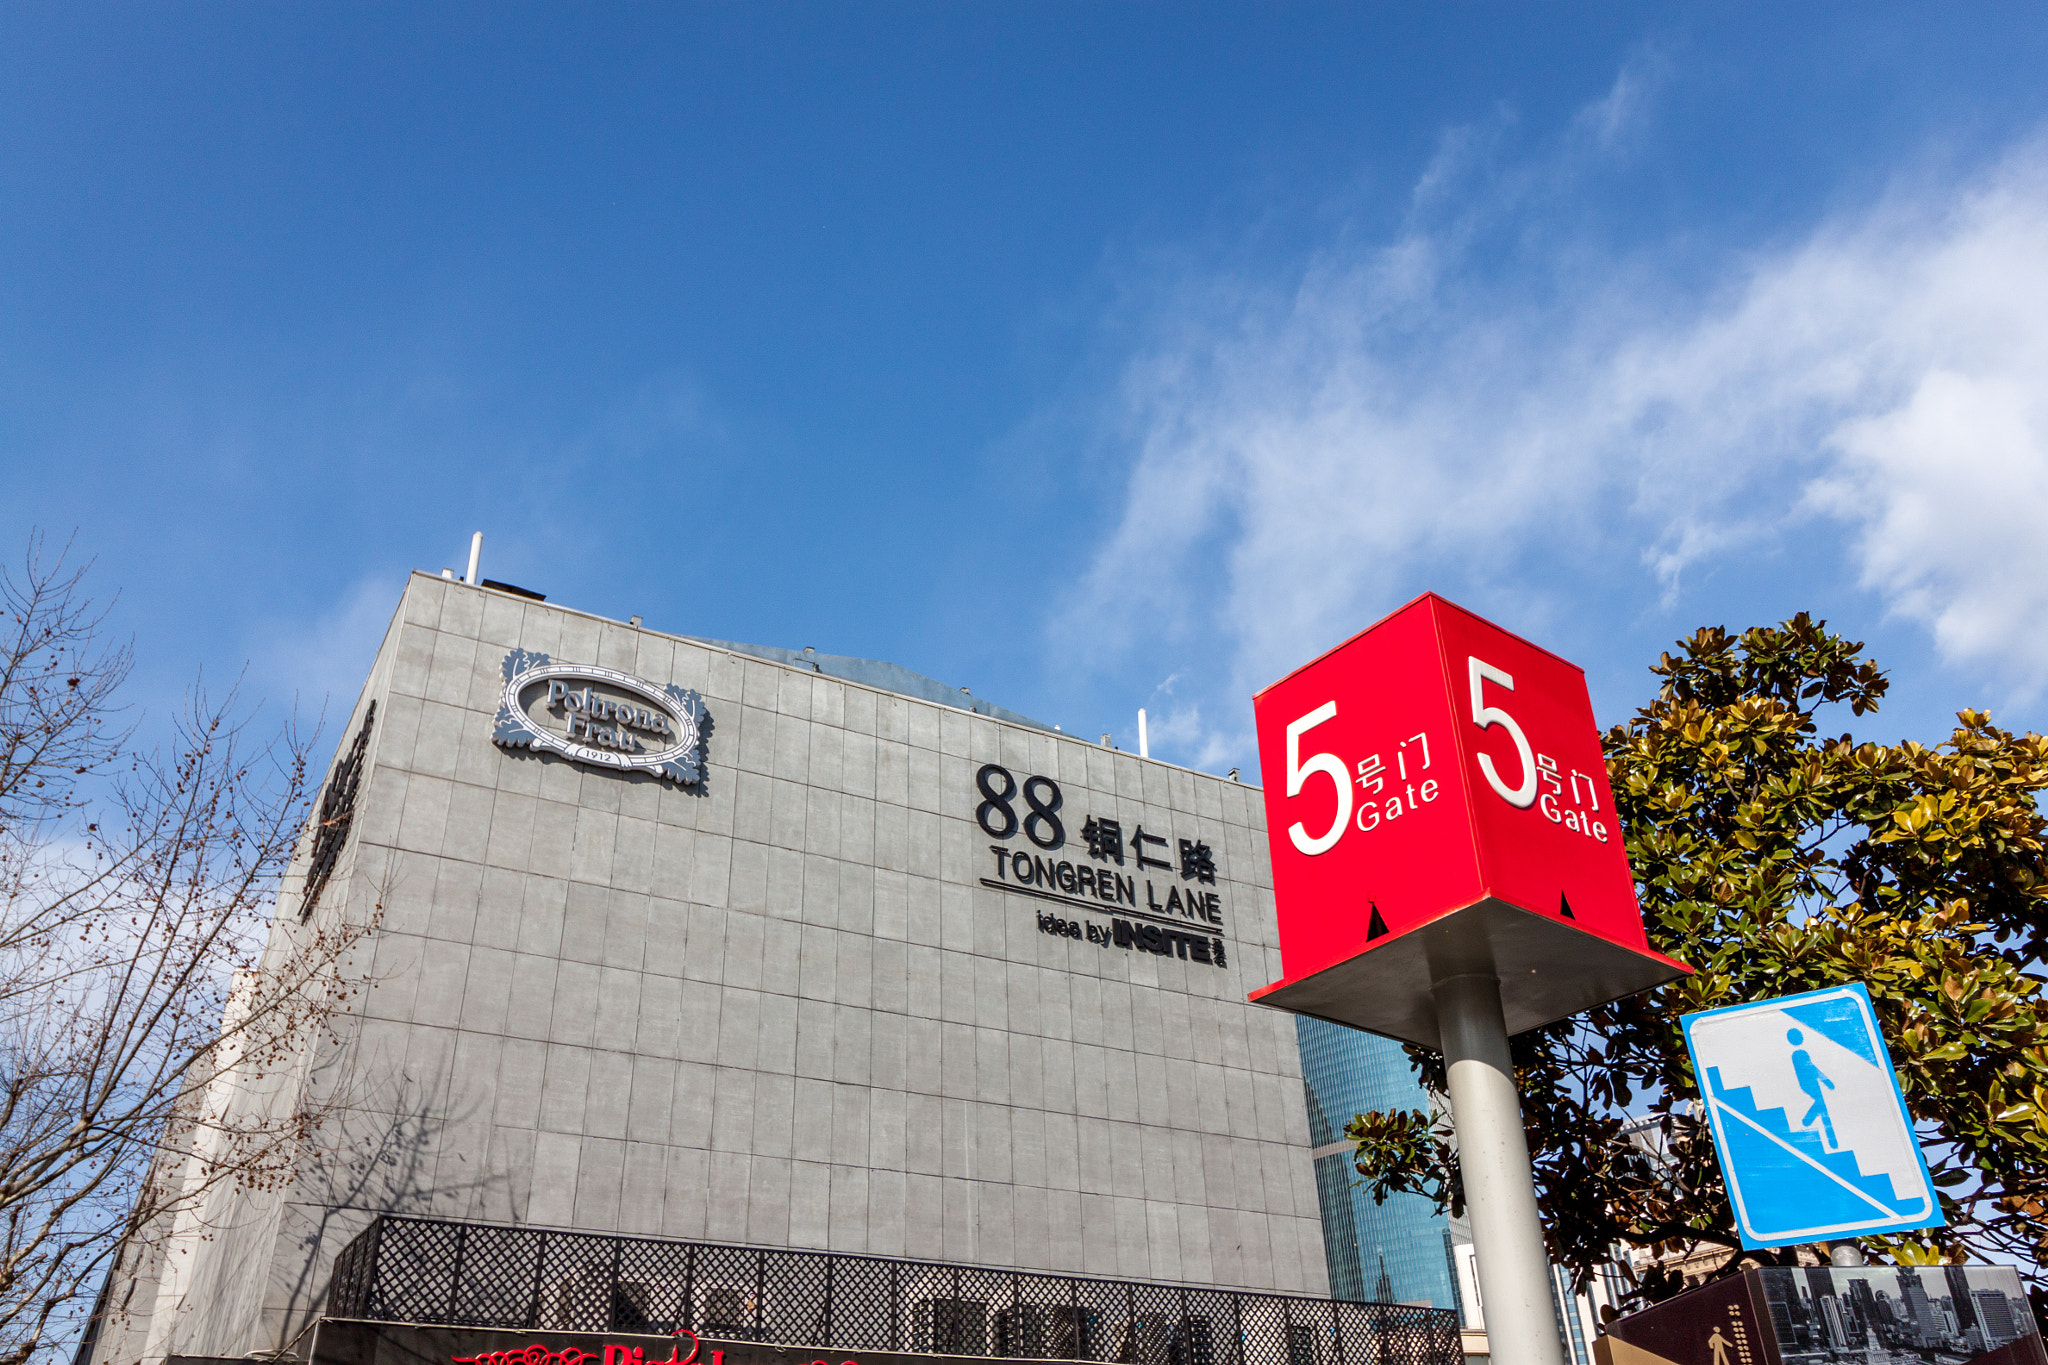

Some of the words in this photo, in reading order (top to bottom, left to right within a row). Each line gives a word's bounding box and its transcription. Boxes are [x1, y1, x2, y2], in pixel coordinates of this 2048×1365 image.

[547, 679, 671, 735] Poltrona
[565, 712, 637, 752] Frau
[1468, 656, 1538, 809] 5
[585, 750, 611, 762] 1912
[1287, 700, 1353, 856] 5
[1356, 732, 1431, 795] 号门
[1536, 752, 1599, 812] 号门
[976, 763, 1064, 849] 88
[1356, 778, 1439, 832] Gate
[1540, 794, 1607, 843] Gate
[1080, 814, 1215, 882] 铜仁路
[989, 845, 1133, 904] TONGREN
[1146, 879, 1222, 923] LANE
[1036, 909, 1081, 939] idea
[1086, 920, 1111, 946] by
[1112, 918, 1211, 962] INSITE
